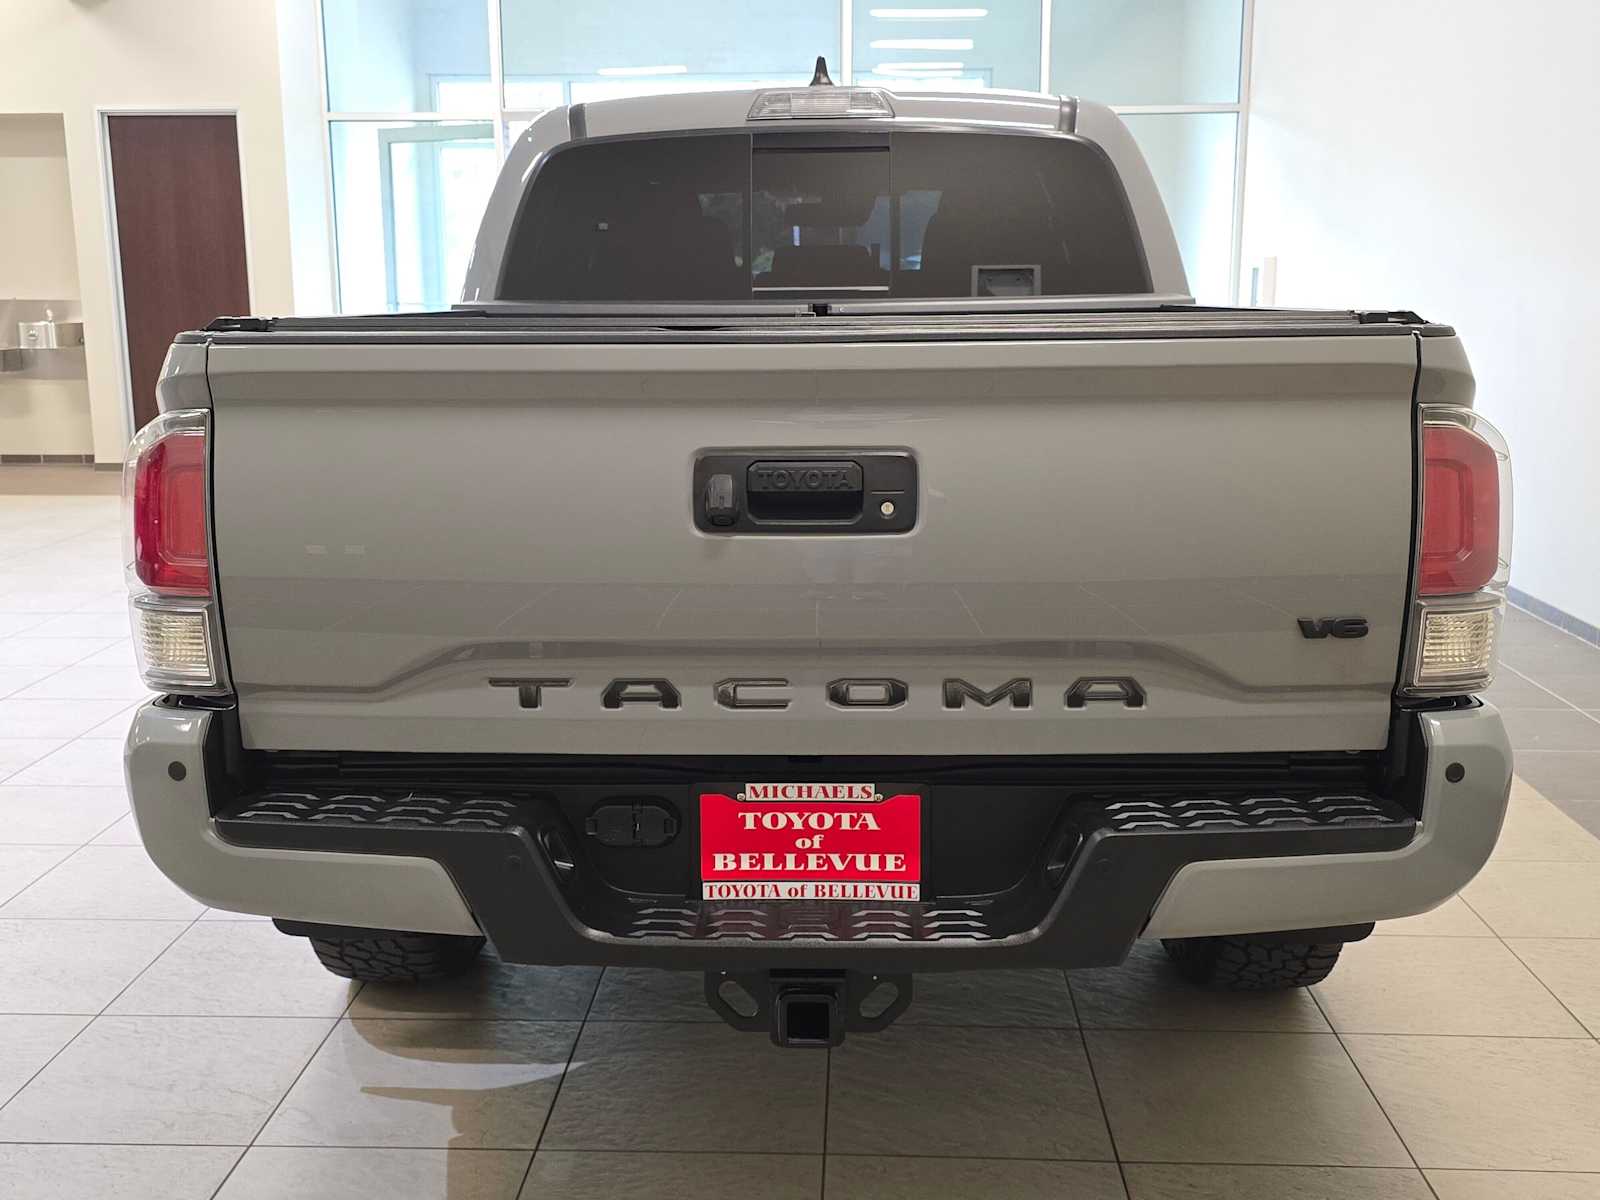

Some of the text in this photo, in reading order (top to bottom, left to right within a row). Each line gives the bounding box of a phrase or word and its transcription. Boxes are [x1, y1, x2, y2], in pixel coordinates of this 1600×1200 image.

[757, 469, 850, 491] TOYOTA
[1297, 617, 1369, 639] V6
[488, 677, 1147, 710] TACOMA
[749, 785, 873, 800] MICHAELS
[738, 811, 881, 831] TOYOTA
[795, 834, 825, 849] of
[712, 853, 907, 872] BELLEVUE
[704, 884, 919, 900] TOYOTA of BELLEVUE
